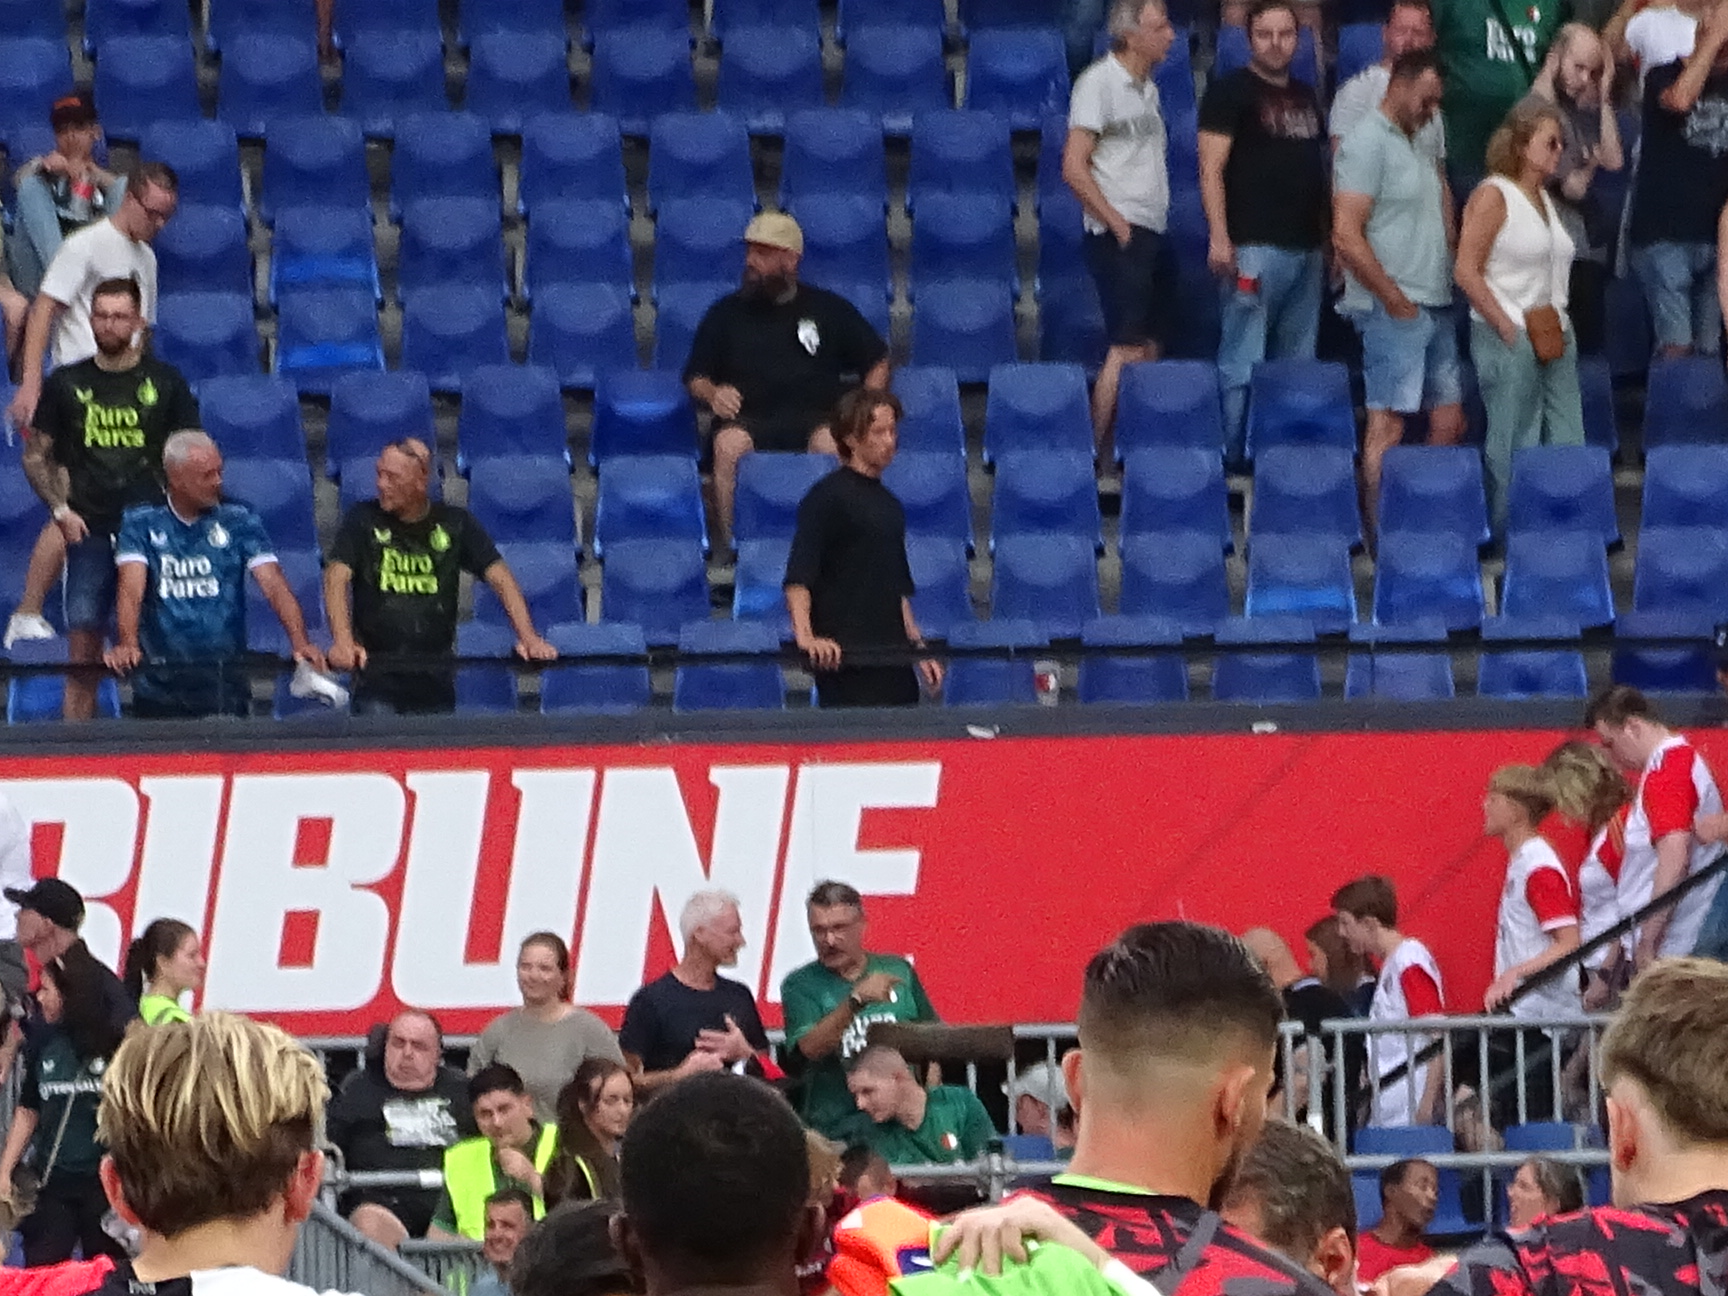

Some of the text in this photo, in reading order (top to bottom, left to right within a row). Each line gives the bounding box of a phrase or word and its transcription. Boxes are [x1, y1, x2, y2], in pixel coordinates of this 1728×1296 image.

[85, 404, 139, 428] Euro
[159, 554, 213, 577] Euro
[381, 548, 434, 574] Euro
[158, 574, 220, 599] Parcs
[380, 570, 438, 594] Parcs
